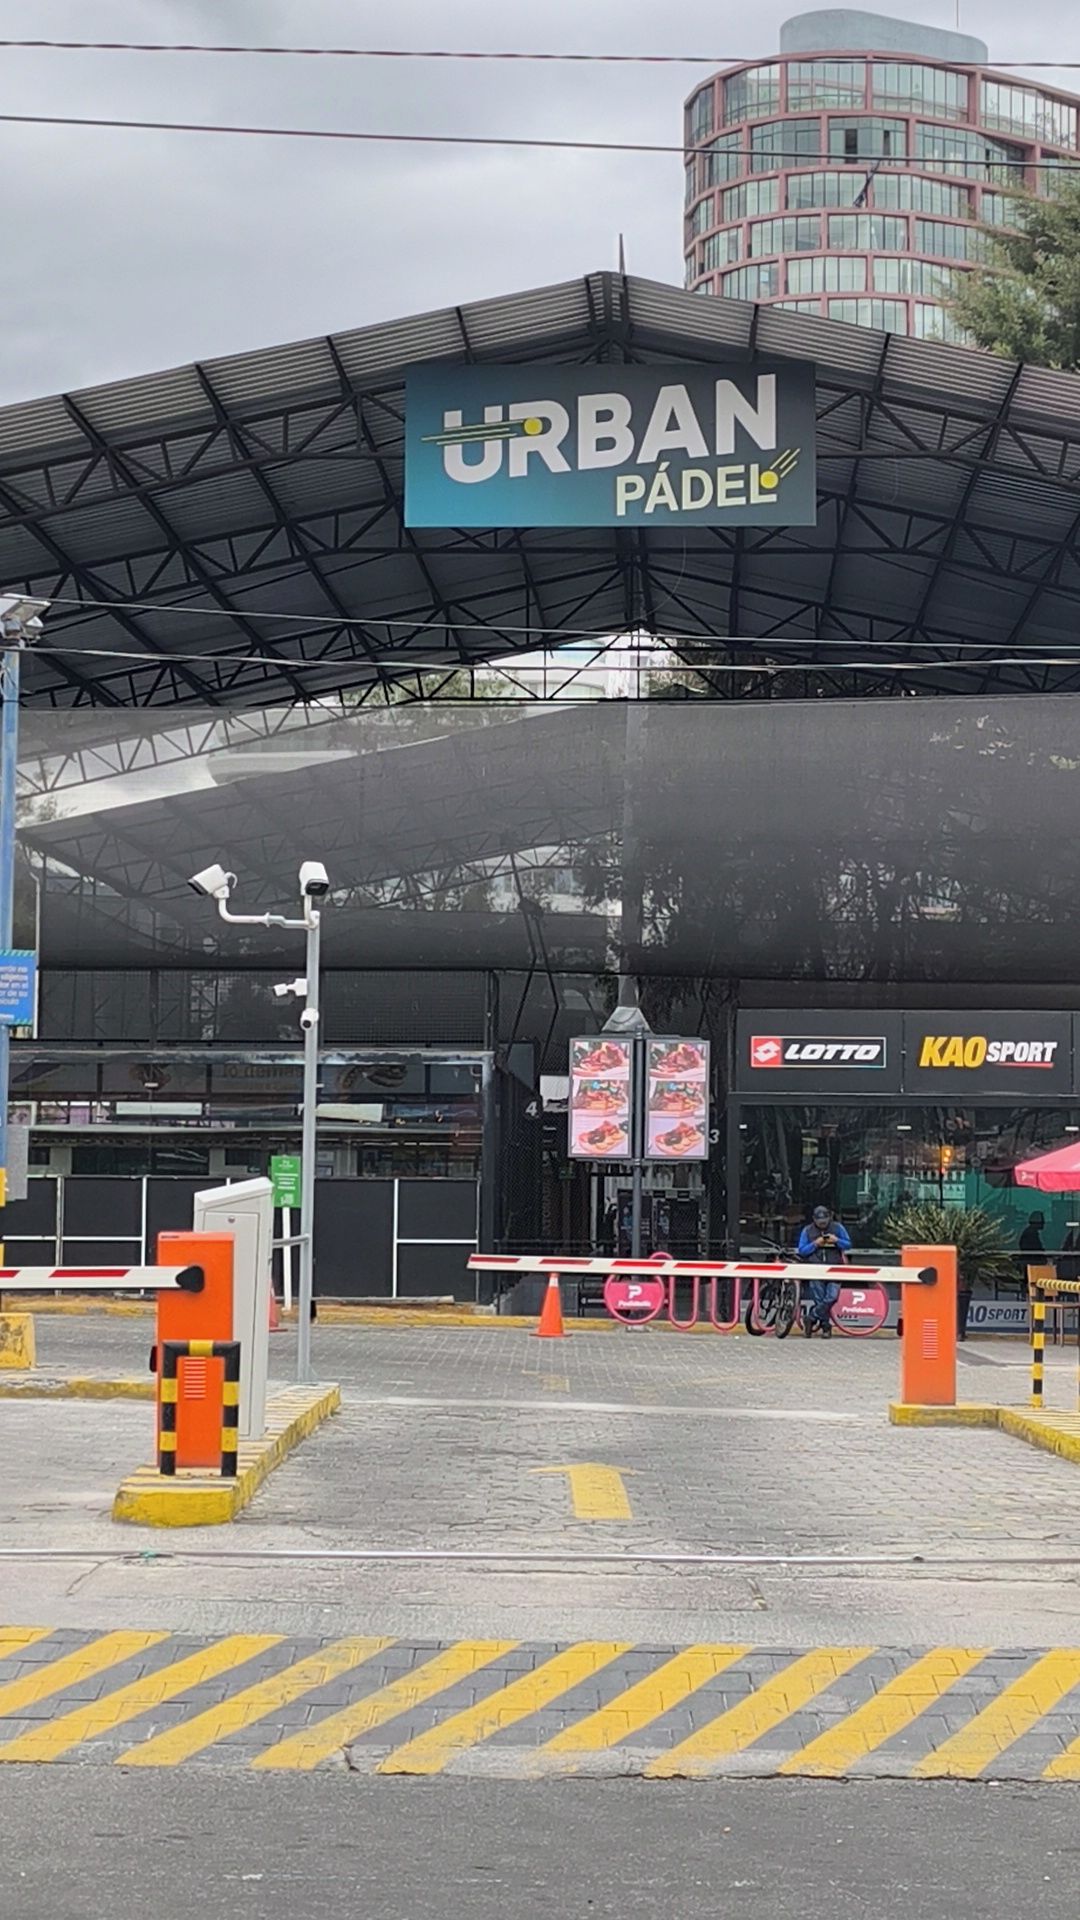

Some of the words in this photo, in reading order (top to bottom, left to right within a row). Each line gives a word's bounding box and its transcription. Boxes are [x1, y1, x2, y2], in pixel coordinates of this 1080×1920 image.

[443, 373, 777, 484] URBAN
[615, 461, 778, 517] PÁDEL
[784, 1043, 881, 1061] LOTTO
[918, 1036, 987, 1068] KAO
[985, 1041, 1058, 1063] SPORT
[525, 1101, 538, 1116] 4
[708, 1128, 720, 1144] 3
[966, 1305, 987, 1323] AO
[987, 1308, 1028, 1321] SPORT
